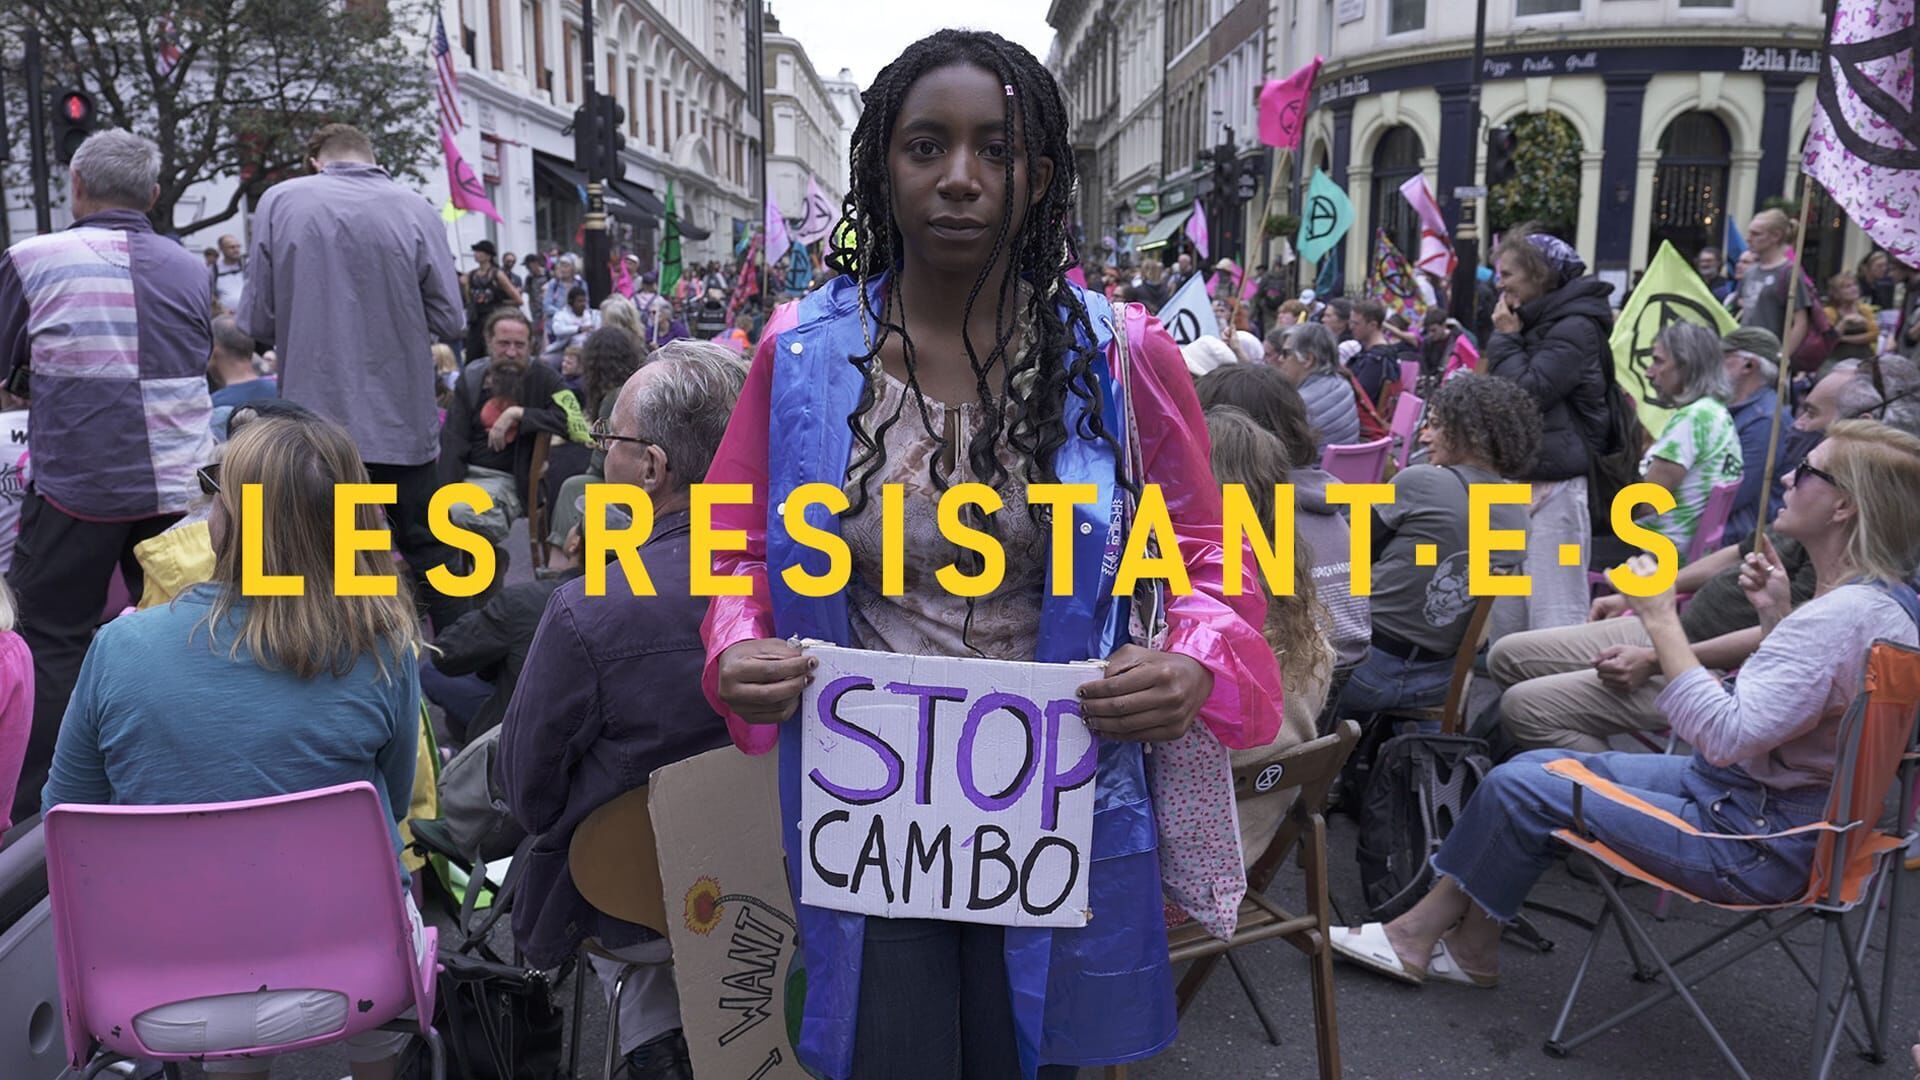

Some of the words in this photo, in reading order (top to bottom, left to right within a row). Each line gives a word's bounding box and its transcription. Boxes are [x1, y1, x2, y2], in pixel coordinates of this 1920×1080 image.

[1739, 47, 1785, 71] Bella
[1787, 48, 1822, 73] Itali
[808, 675, 1098, 832] STOP
[809, 809, 1080, 916] CAMBO
[718, 906, 784, 1047] WANT
